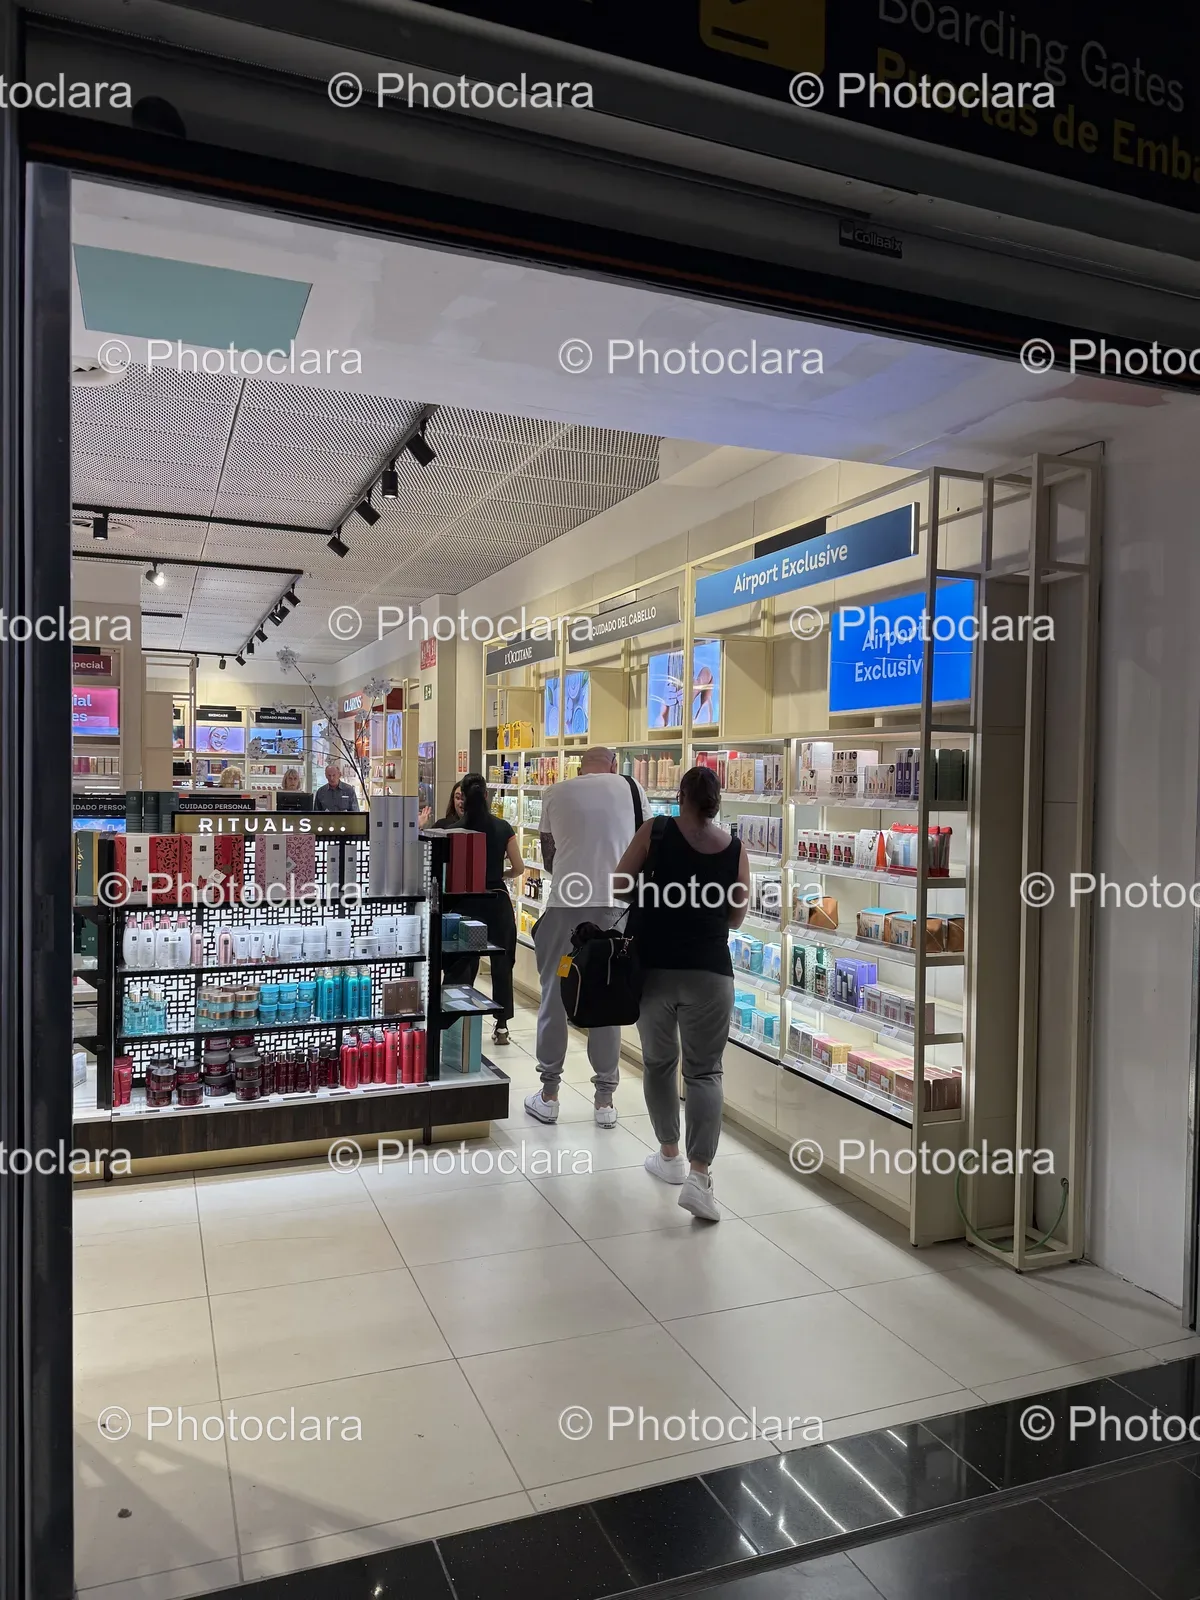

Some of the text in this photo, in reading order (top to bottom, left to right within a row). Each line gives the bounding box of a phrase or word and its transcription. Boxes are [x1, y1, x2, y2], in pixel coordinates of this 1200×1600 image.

[1081, 41, 1185, 113] Gates
[1052, 104, 1099, 154] de
[733, 544, 848, 594] Airport Exclusive
[593, 606, 657, 636] CUIDADO DEL CABELLO
[73, 661, 104, 670] pecial
[855, 653, 923, 682] Exclusiv
